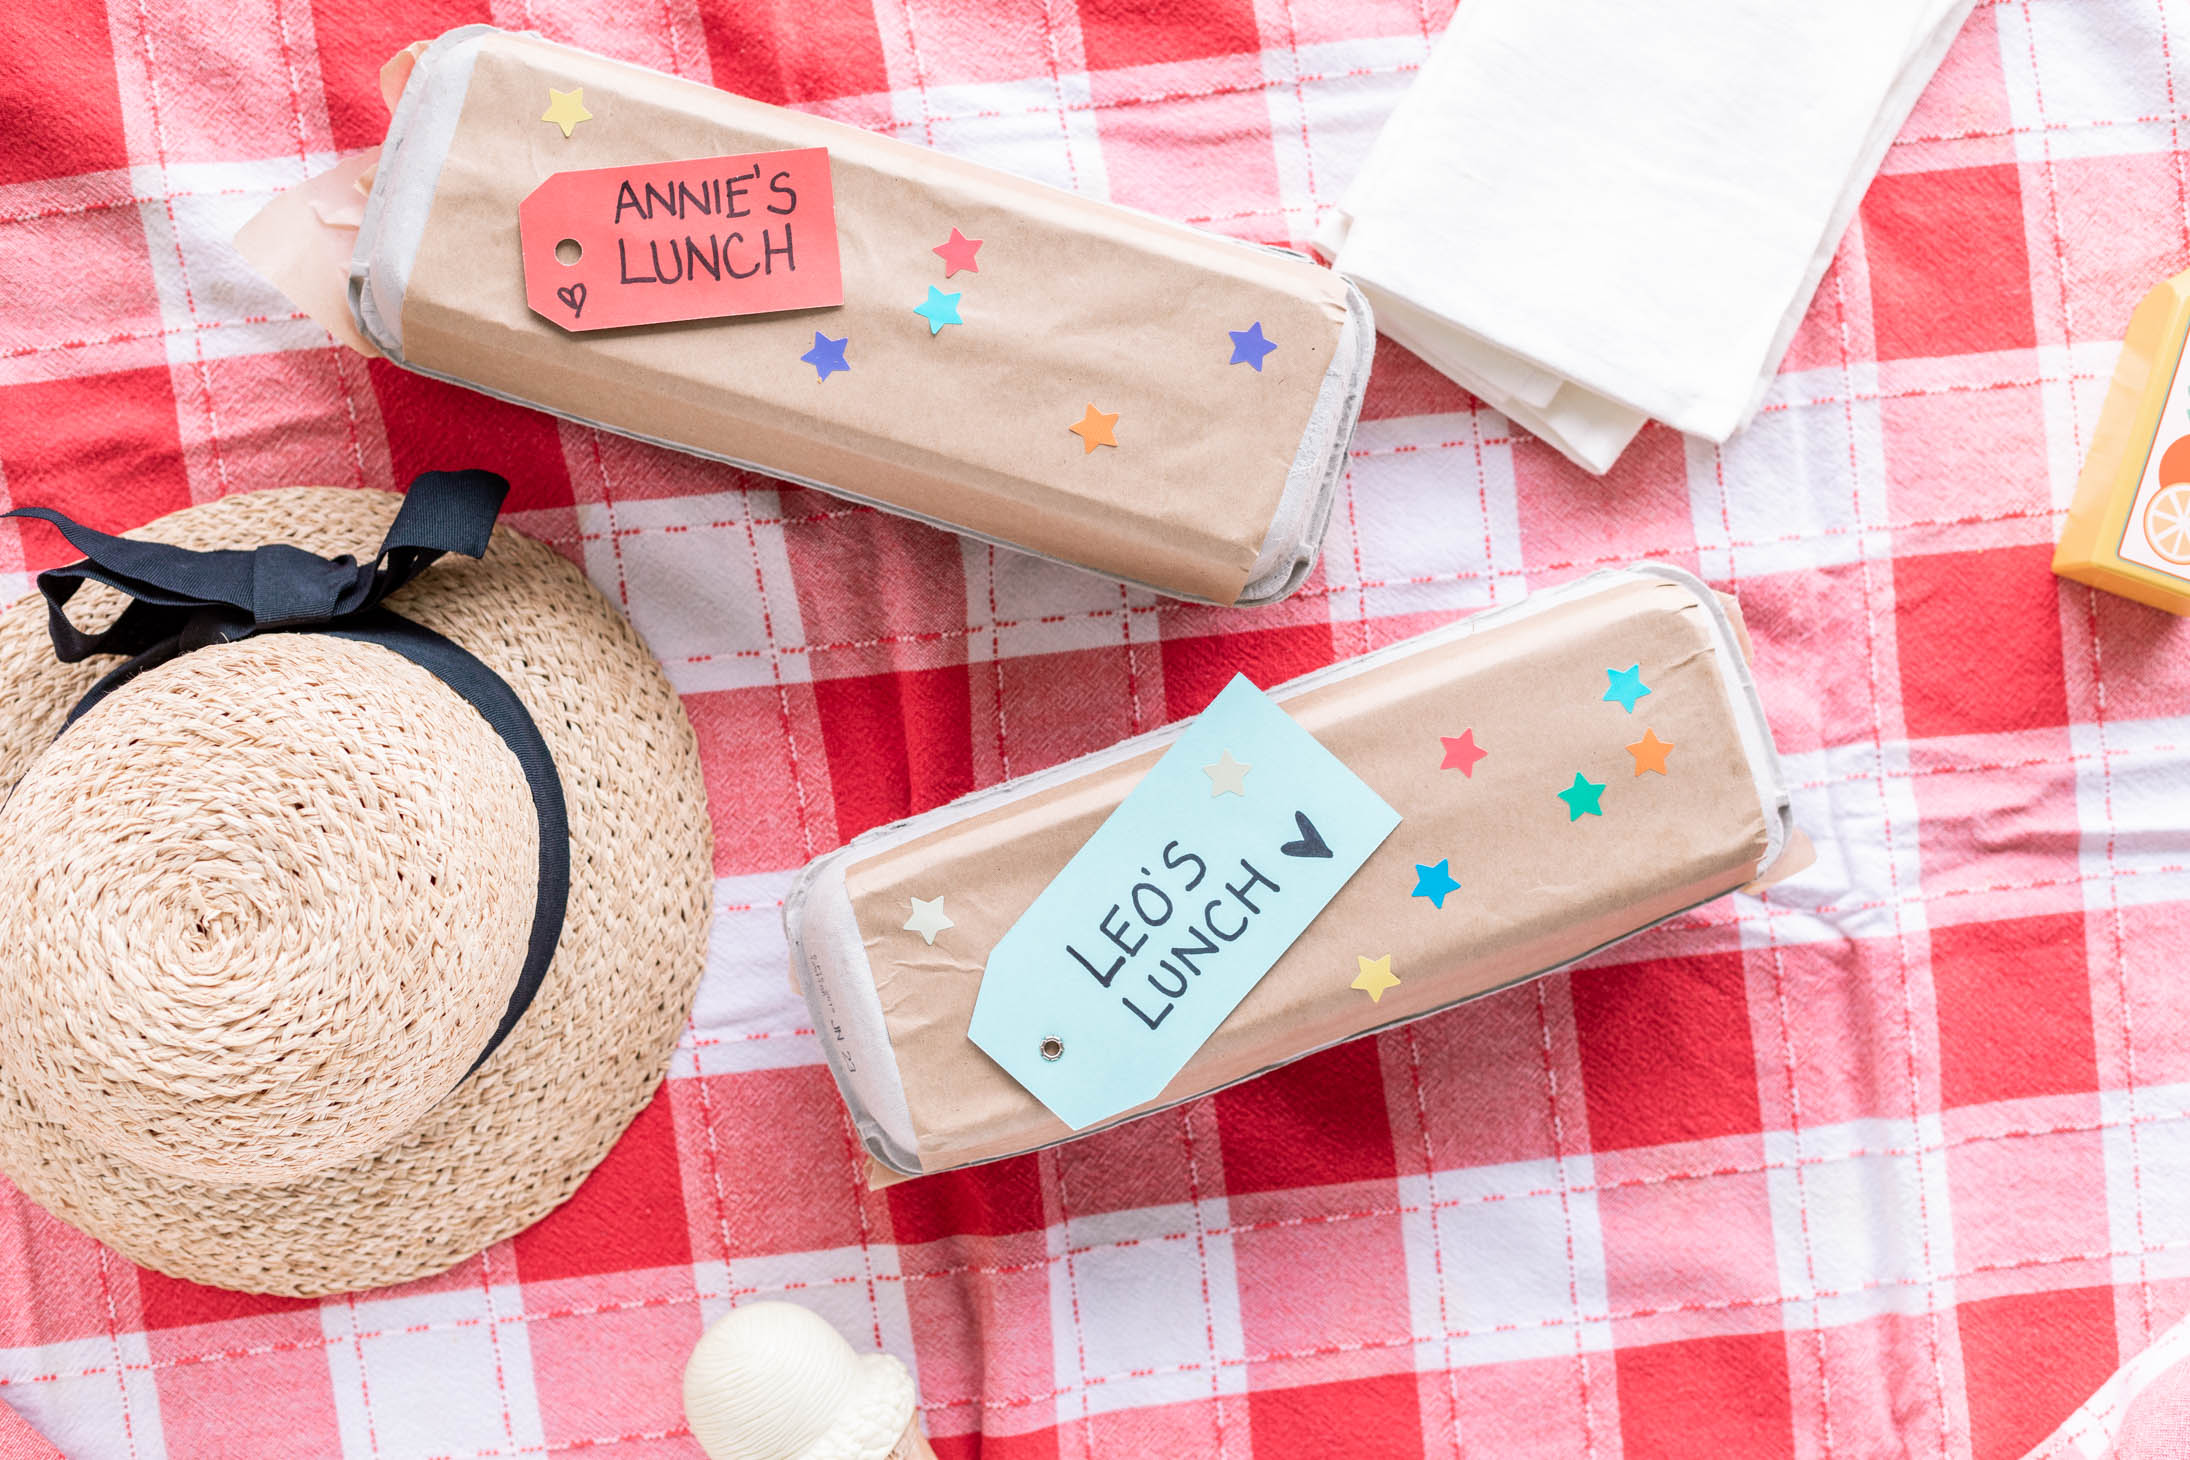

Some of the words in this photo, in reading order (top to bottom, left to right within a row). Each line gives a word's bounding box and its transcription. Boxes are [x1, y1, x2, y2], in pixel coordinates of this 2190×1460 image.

[614, 163, 797, 225] ANNIE'S
[618, 222, 796, 285] LUNCH
[1066, 840, 1207, 989] LEO'S
[1122, 858, 1281, 1031] LUNCH
